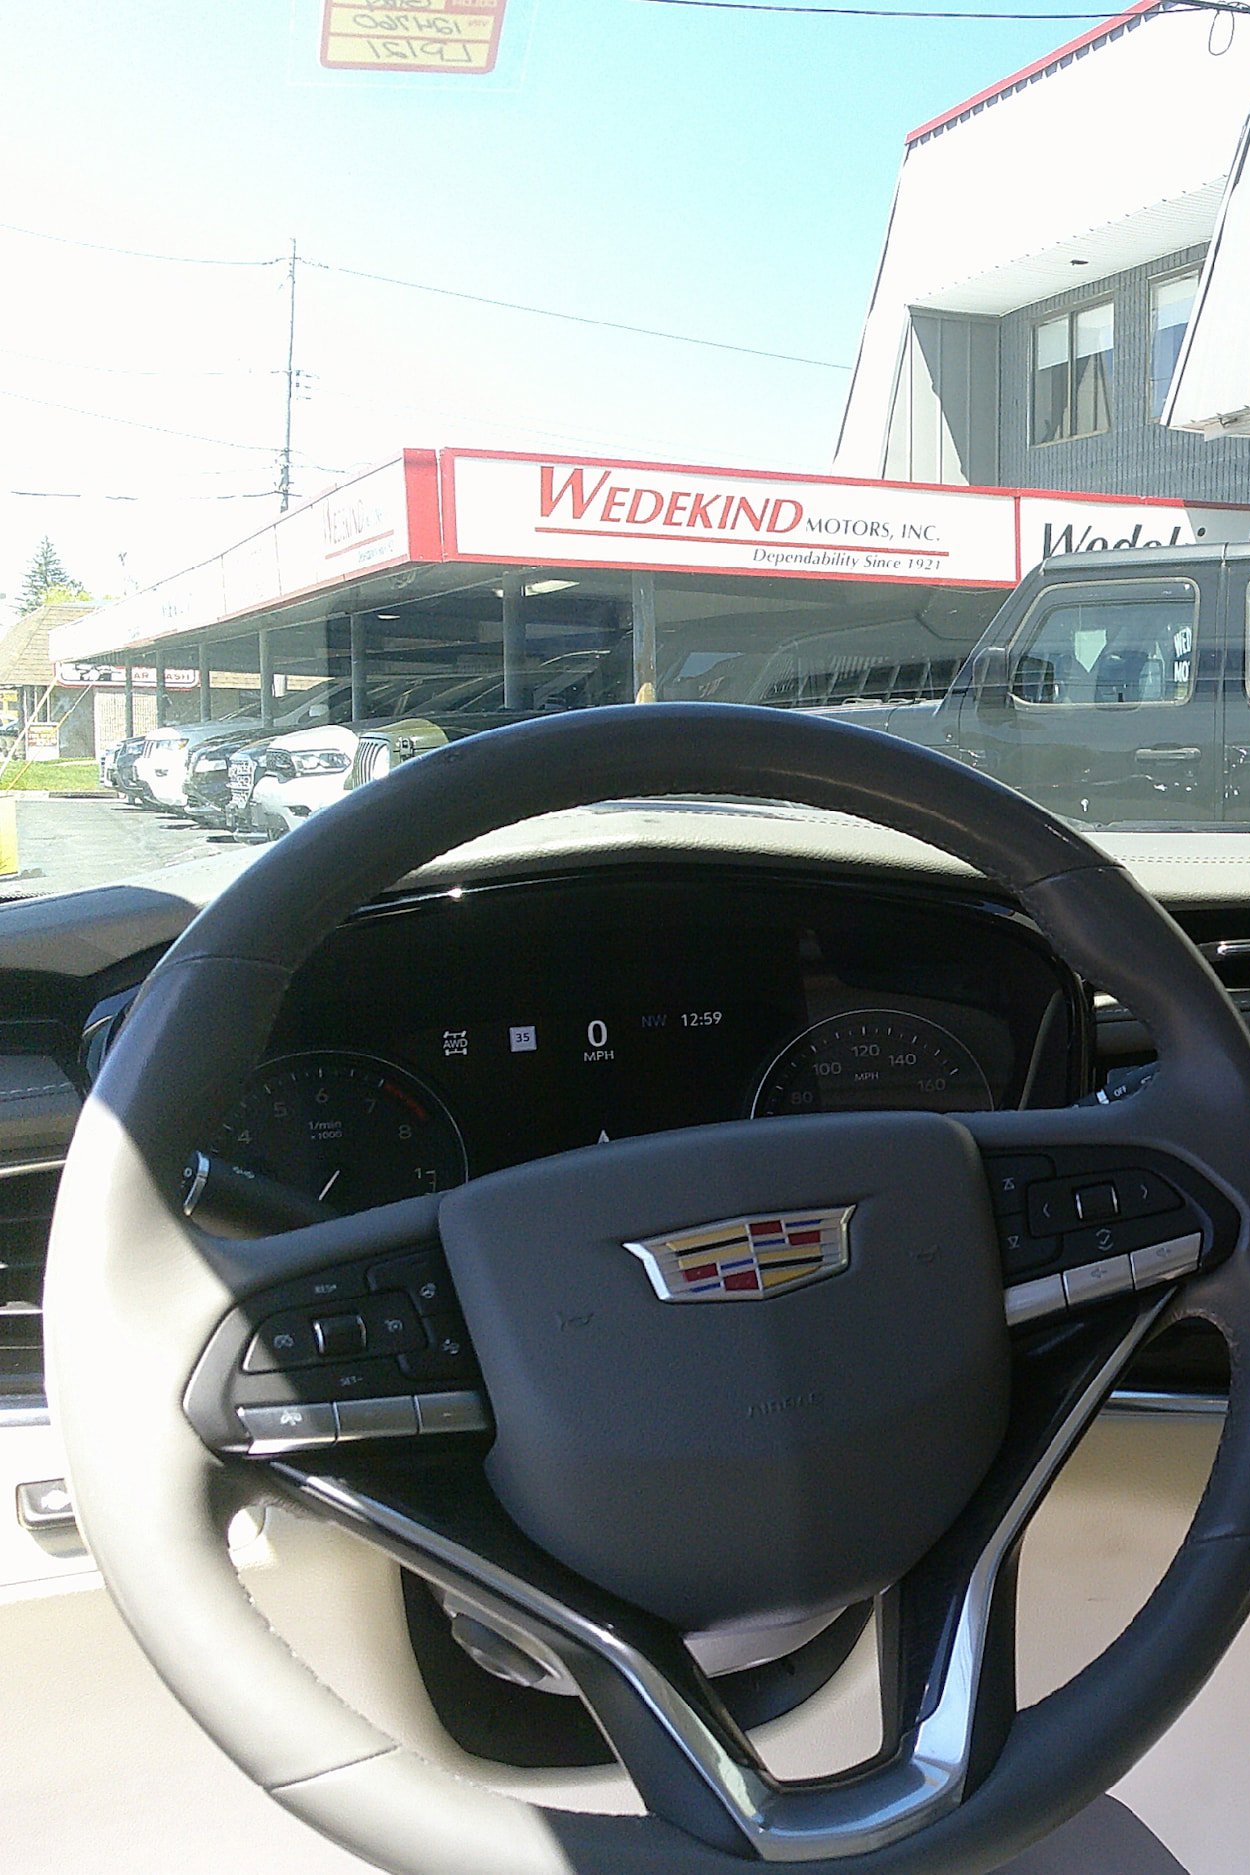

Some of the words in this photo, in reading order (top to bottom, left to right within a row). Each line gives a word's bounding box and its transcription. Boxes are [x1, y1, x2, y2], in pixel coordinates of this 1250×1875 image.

[540, 465, 804, 534] WEDEKIND
[806, 515, 895, 541] MOTORS,
[901, 524, 940, 542] INC.
[753, 547, 861, 570] Dependability
[864, 554, 902, 569] Since
[907, 558, 941, 571] 1921
[680, 1011, 723, 1027] 12:59
[515, 1032, 530, 1043] 35
[586, 1019, 608, 1048] 0
[442, 1038, 468, 1049] AWD
[851, 1043, 880, 1058] 120
[584, 1050, 615, 1062] MPH
[888, 1053, 917, 1067] 140
[812, 1061, 842, 1077] 100
[854, 1070, 879, 1081] MPH
[917, 1077, 946, 1092] 160
[315, 1088, 329, 1104] 6
[274, 1101, 289, 1118] 5
[237, 1129, 252, 1144] 4
[398, 1124, 413, 1139] 8
